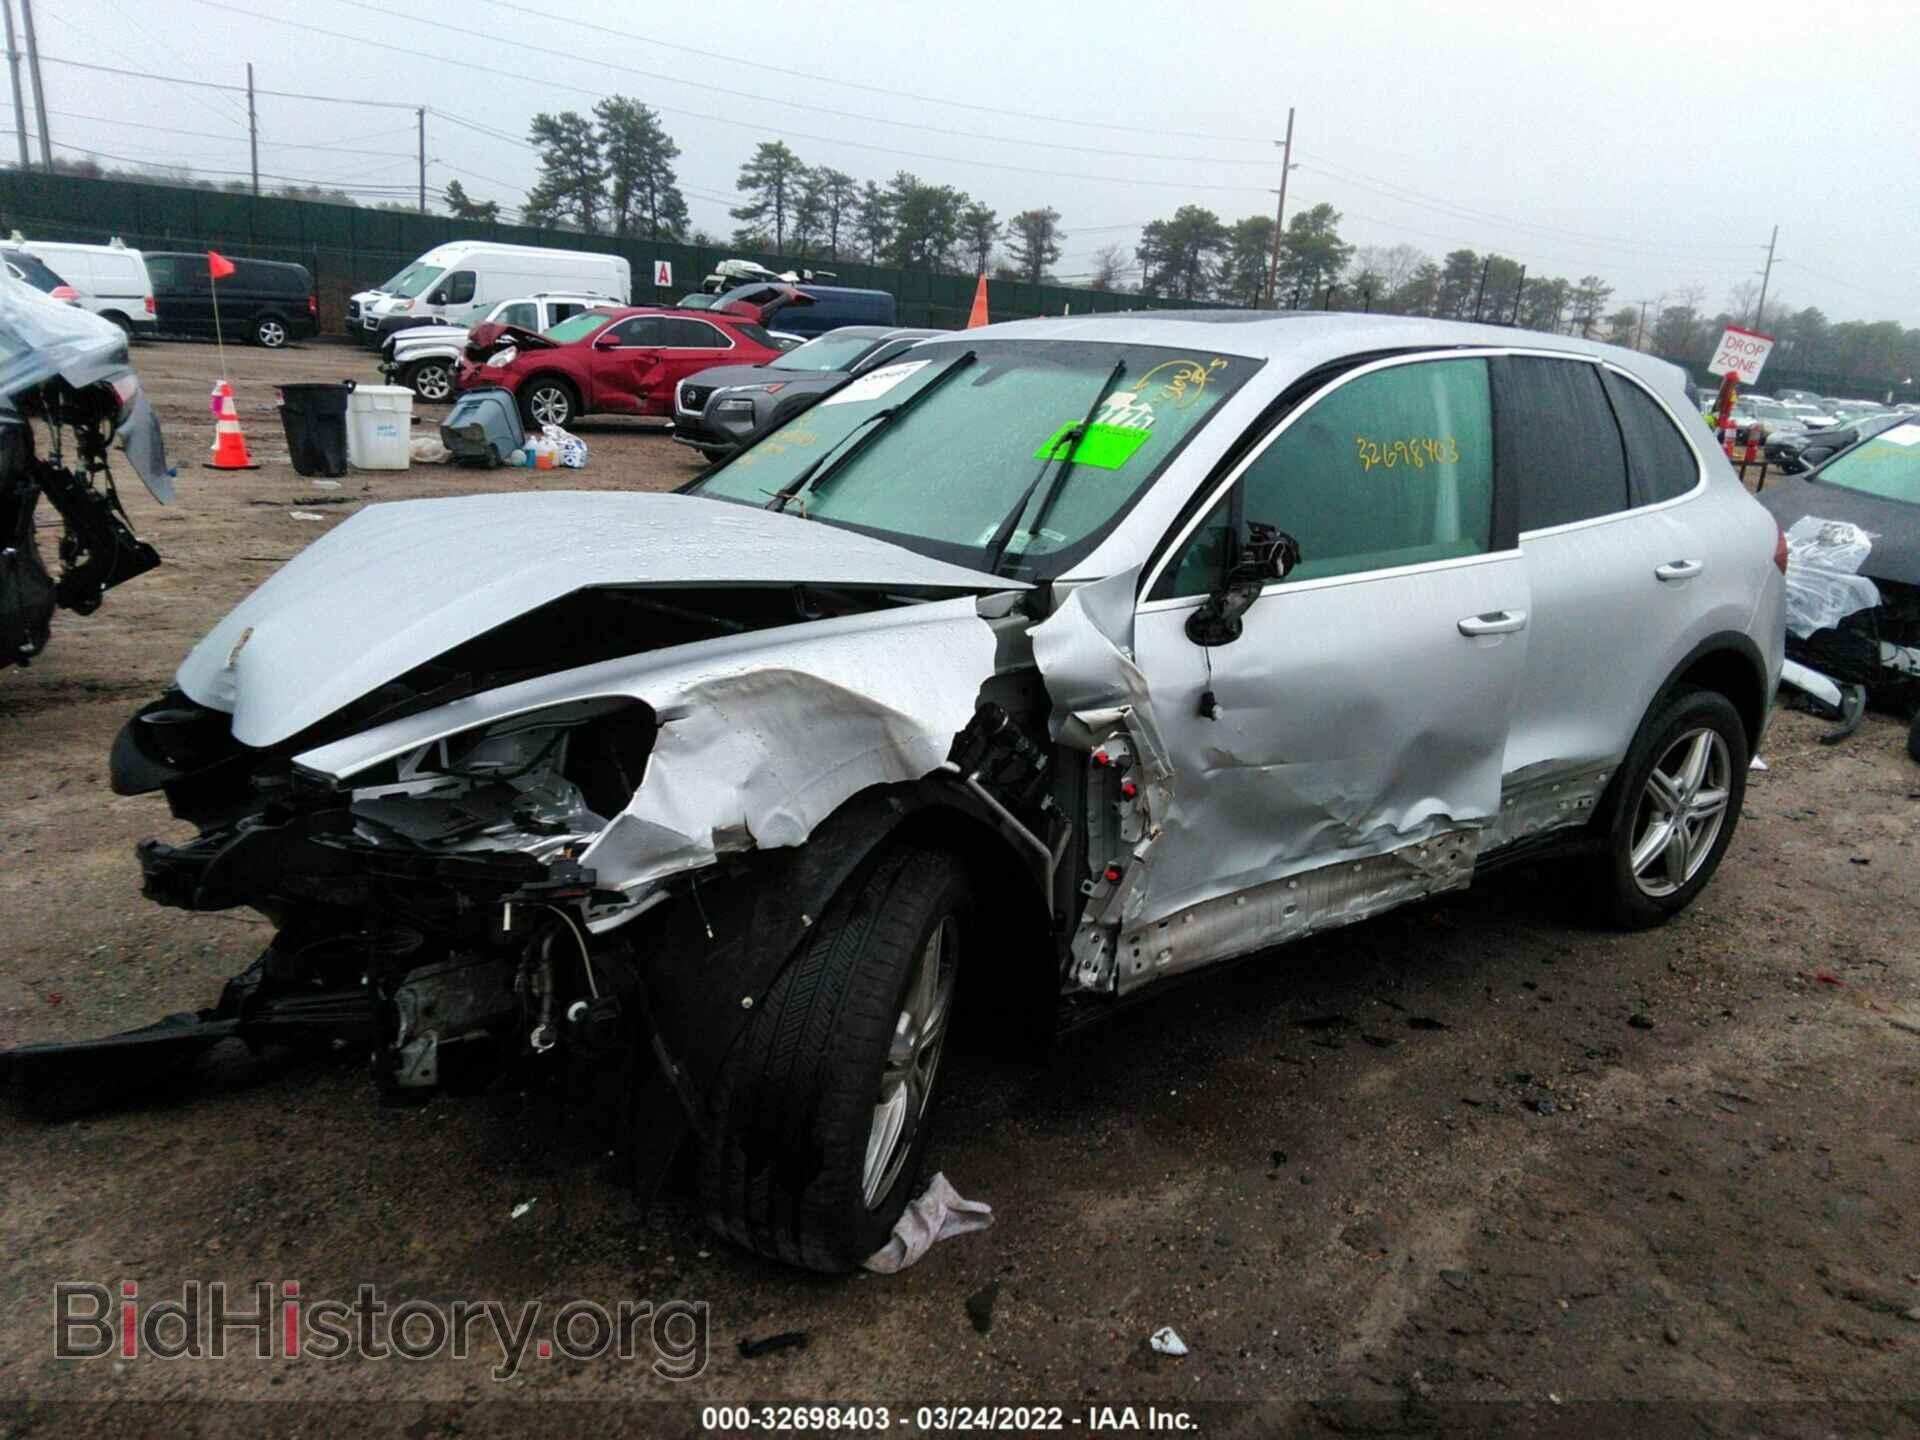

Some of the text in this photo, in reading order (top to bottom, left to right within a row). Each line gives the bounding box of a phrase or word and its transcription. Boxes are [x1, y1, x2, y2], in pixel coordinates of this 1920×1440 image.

[658, 262, 669, 284] A
[1726, 336, 1765, 356] DROP
[1718, 352, 1757, 373] ZONE
[1356, 437, 1459, 472] 32698403
